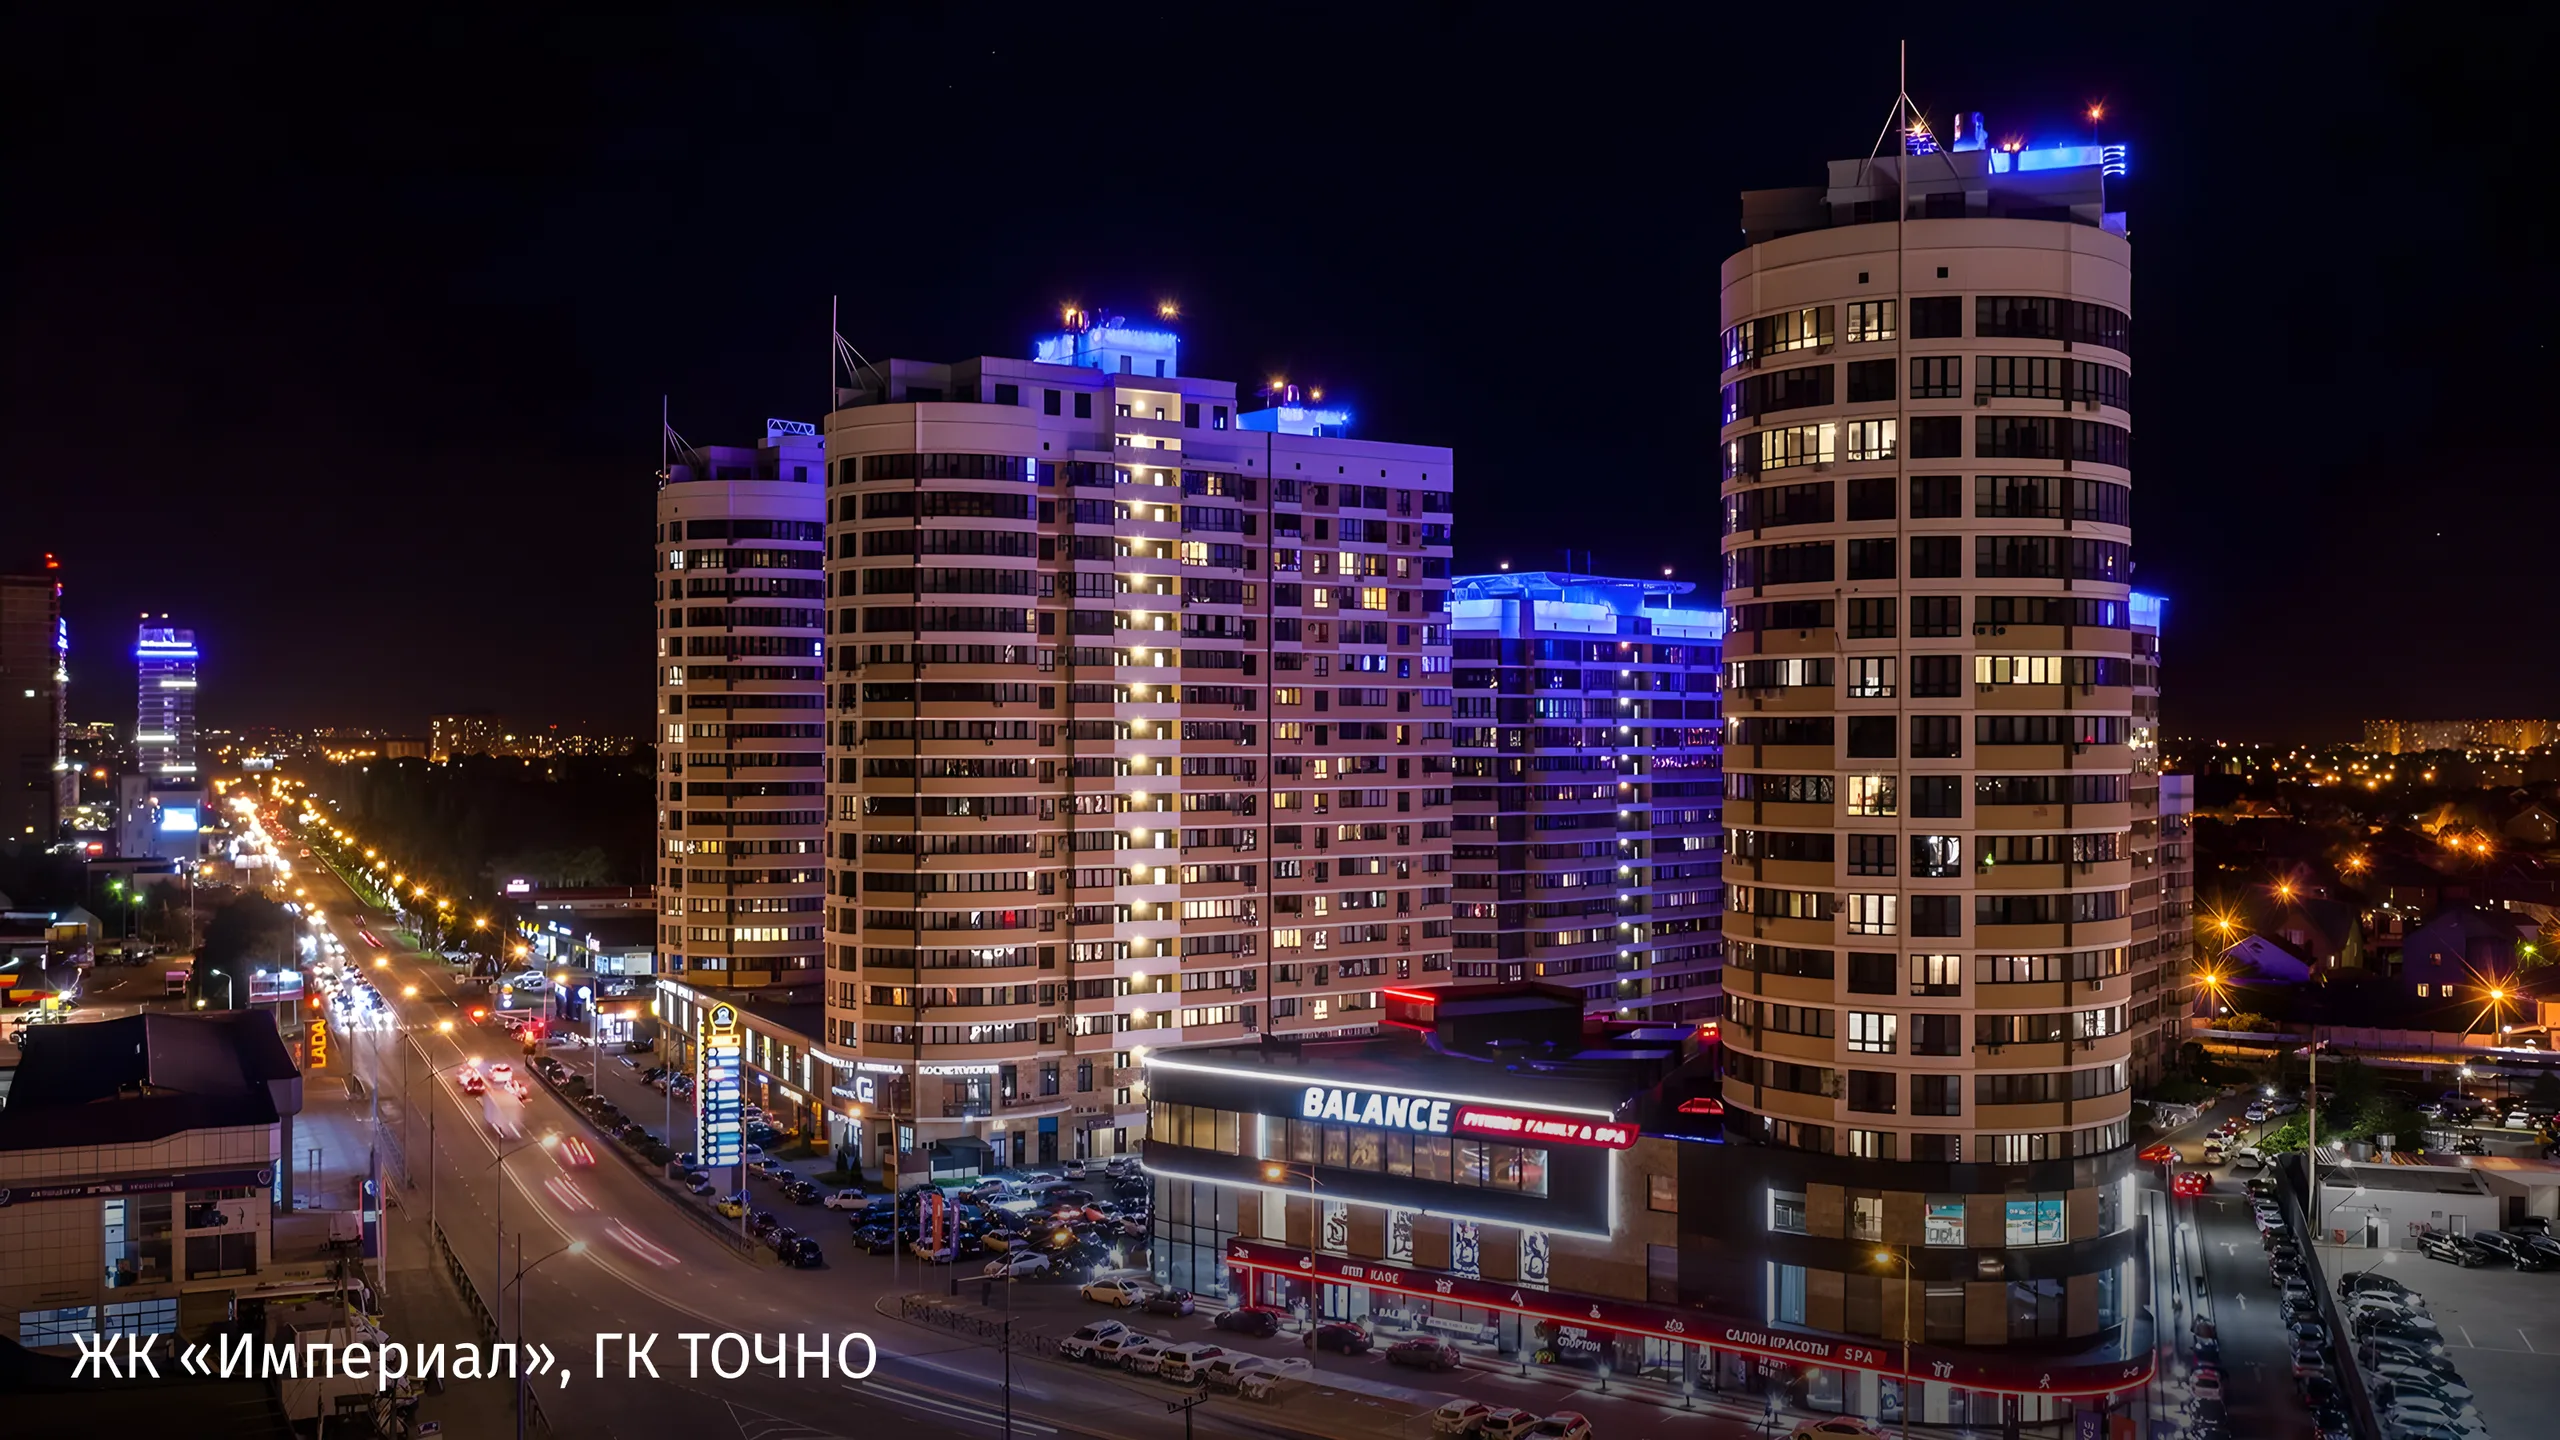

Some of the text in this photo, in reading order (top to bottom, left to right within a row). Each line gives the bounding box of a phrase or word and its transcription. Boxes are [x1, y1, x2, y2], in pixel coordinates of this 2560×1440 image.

[311, 1019, 327, 1069] LADA
[1303, 1087, 1451, 1132] BALANCE
[1594, 1127, 1626, 1144] SPA
[1726, 1328, 1830, 1357] САЛОН КРАСОТЫ
[1844, 1347, 1873, 1364] SPA
